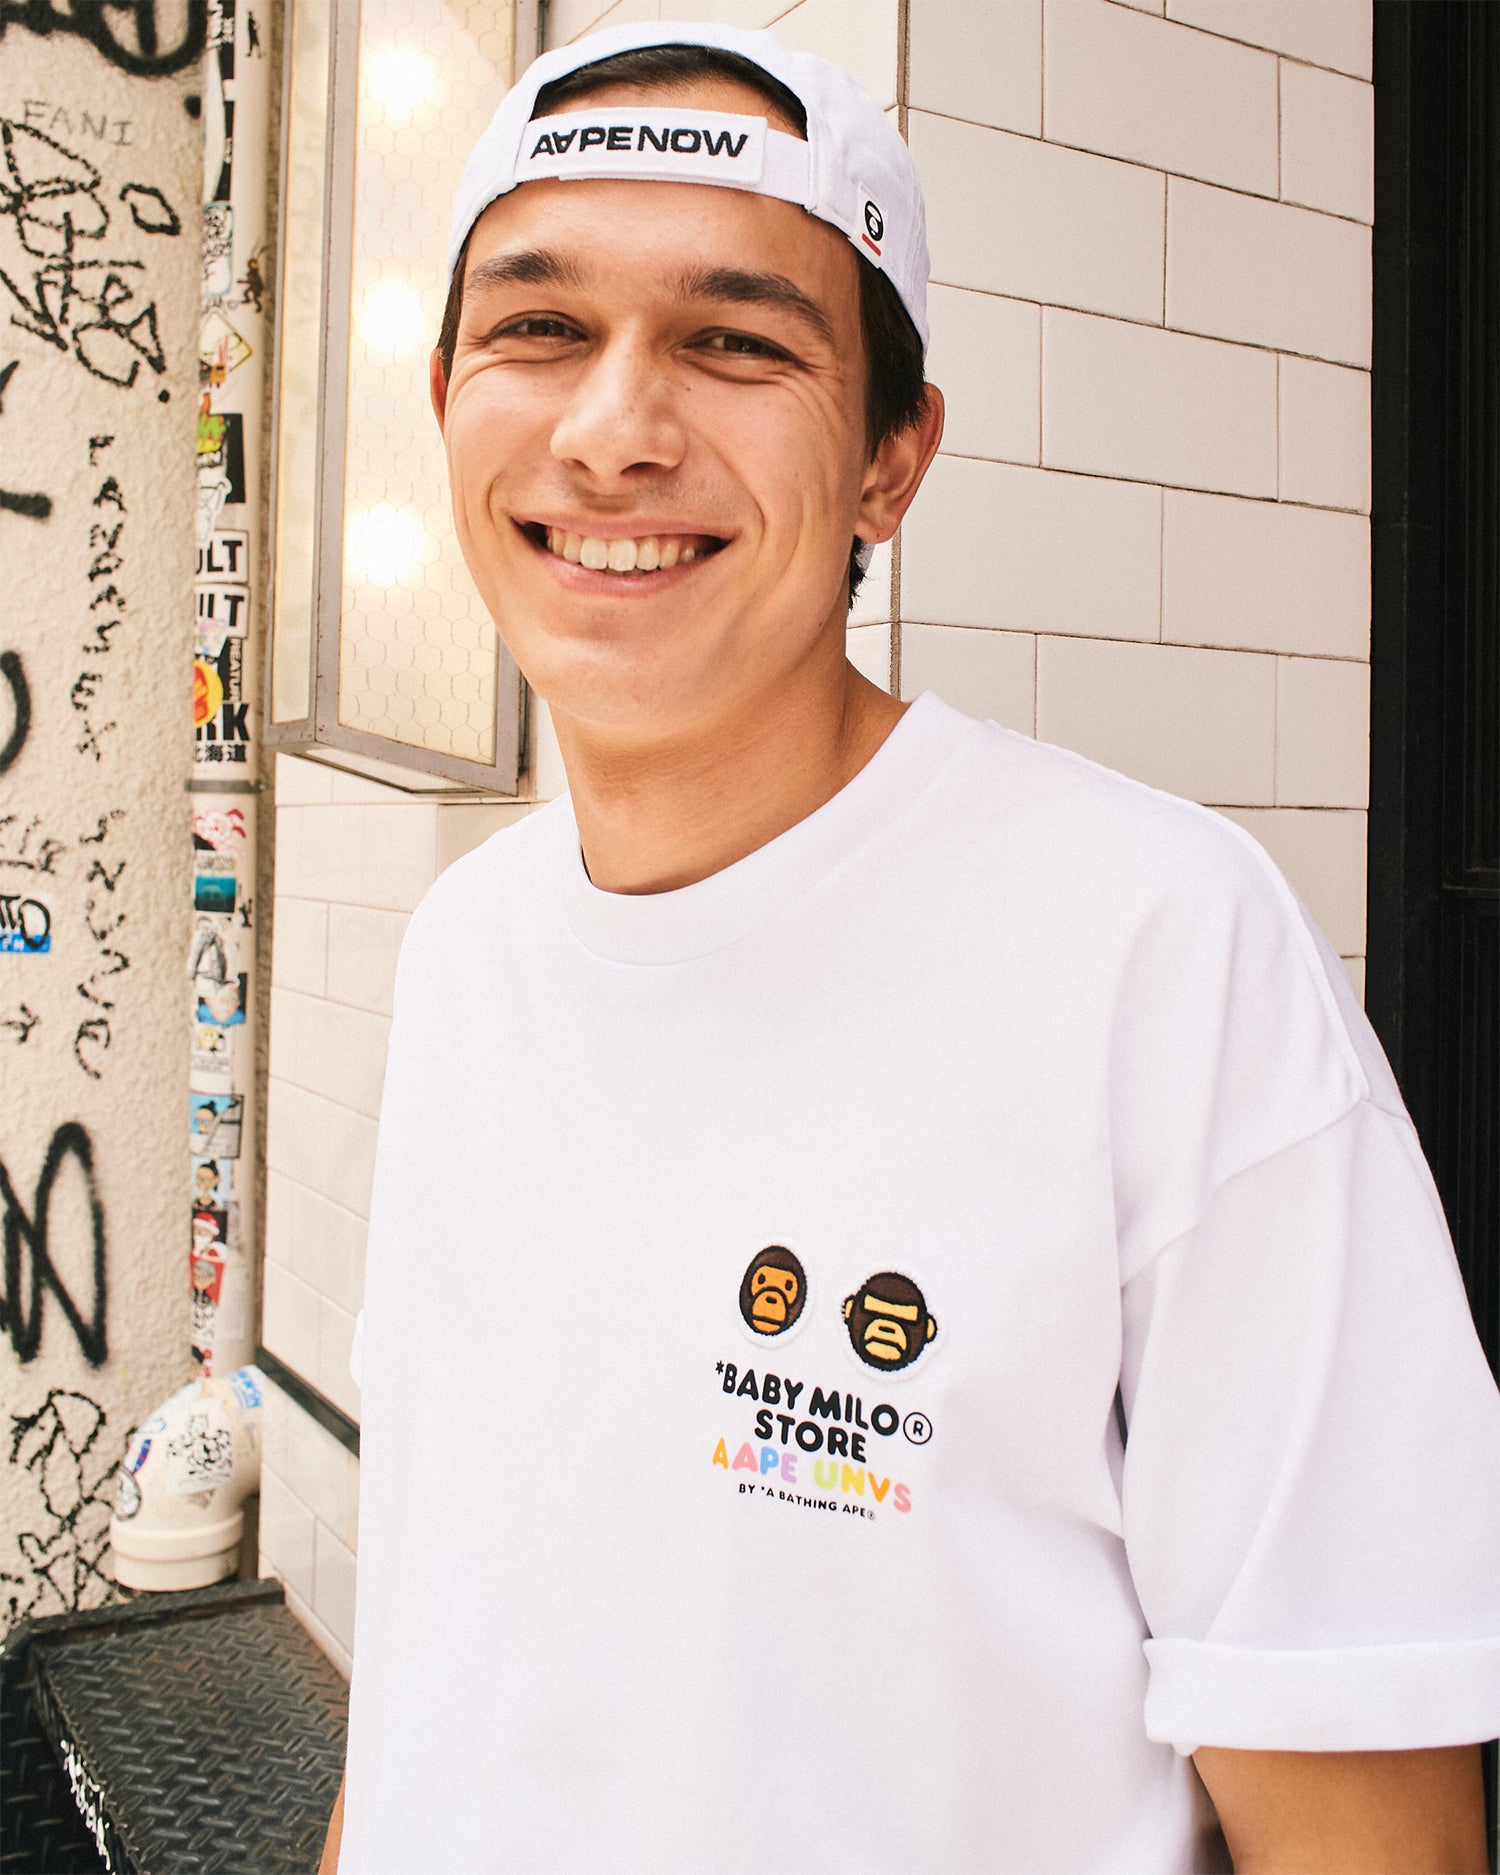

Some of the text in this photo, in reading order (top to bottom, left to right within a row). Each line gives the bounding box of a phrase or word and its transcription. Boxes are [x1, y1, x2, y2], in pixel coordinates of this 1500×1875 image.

[754, 1409, 867, 1464] STORE
[712, 1437, 912, 1513] AAPE UNVS
[738, 1483, 755, 1494] BY
[779, 1490, 838, 1512] BATHING
